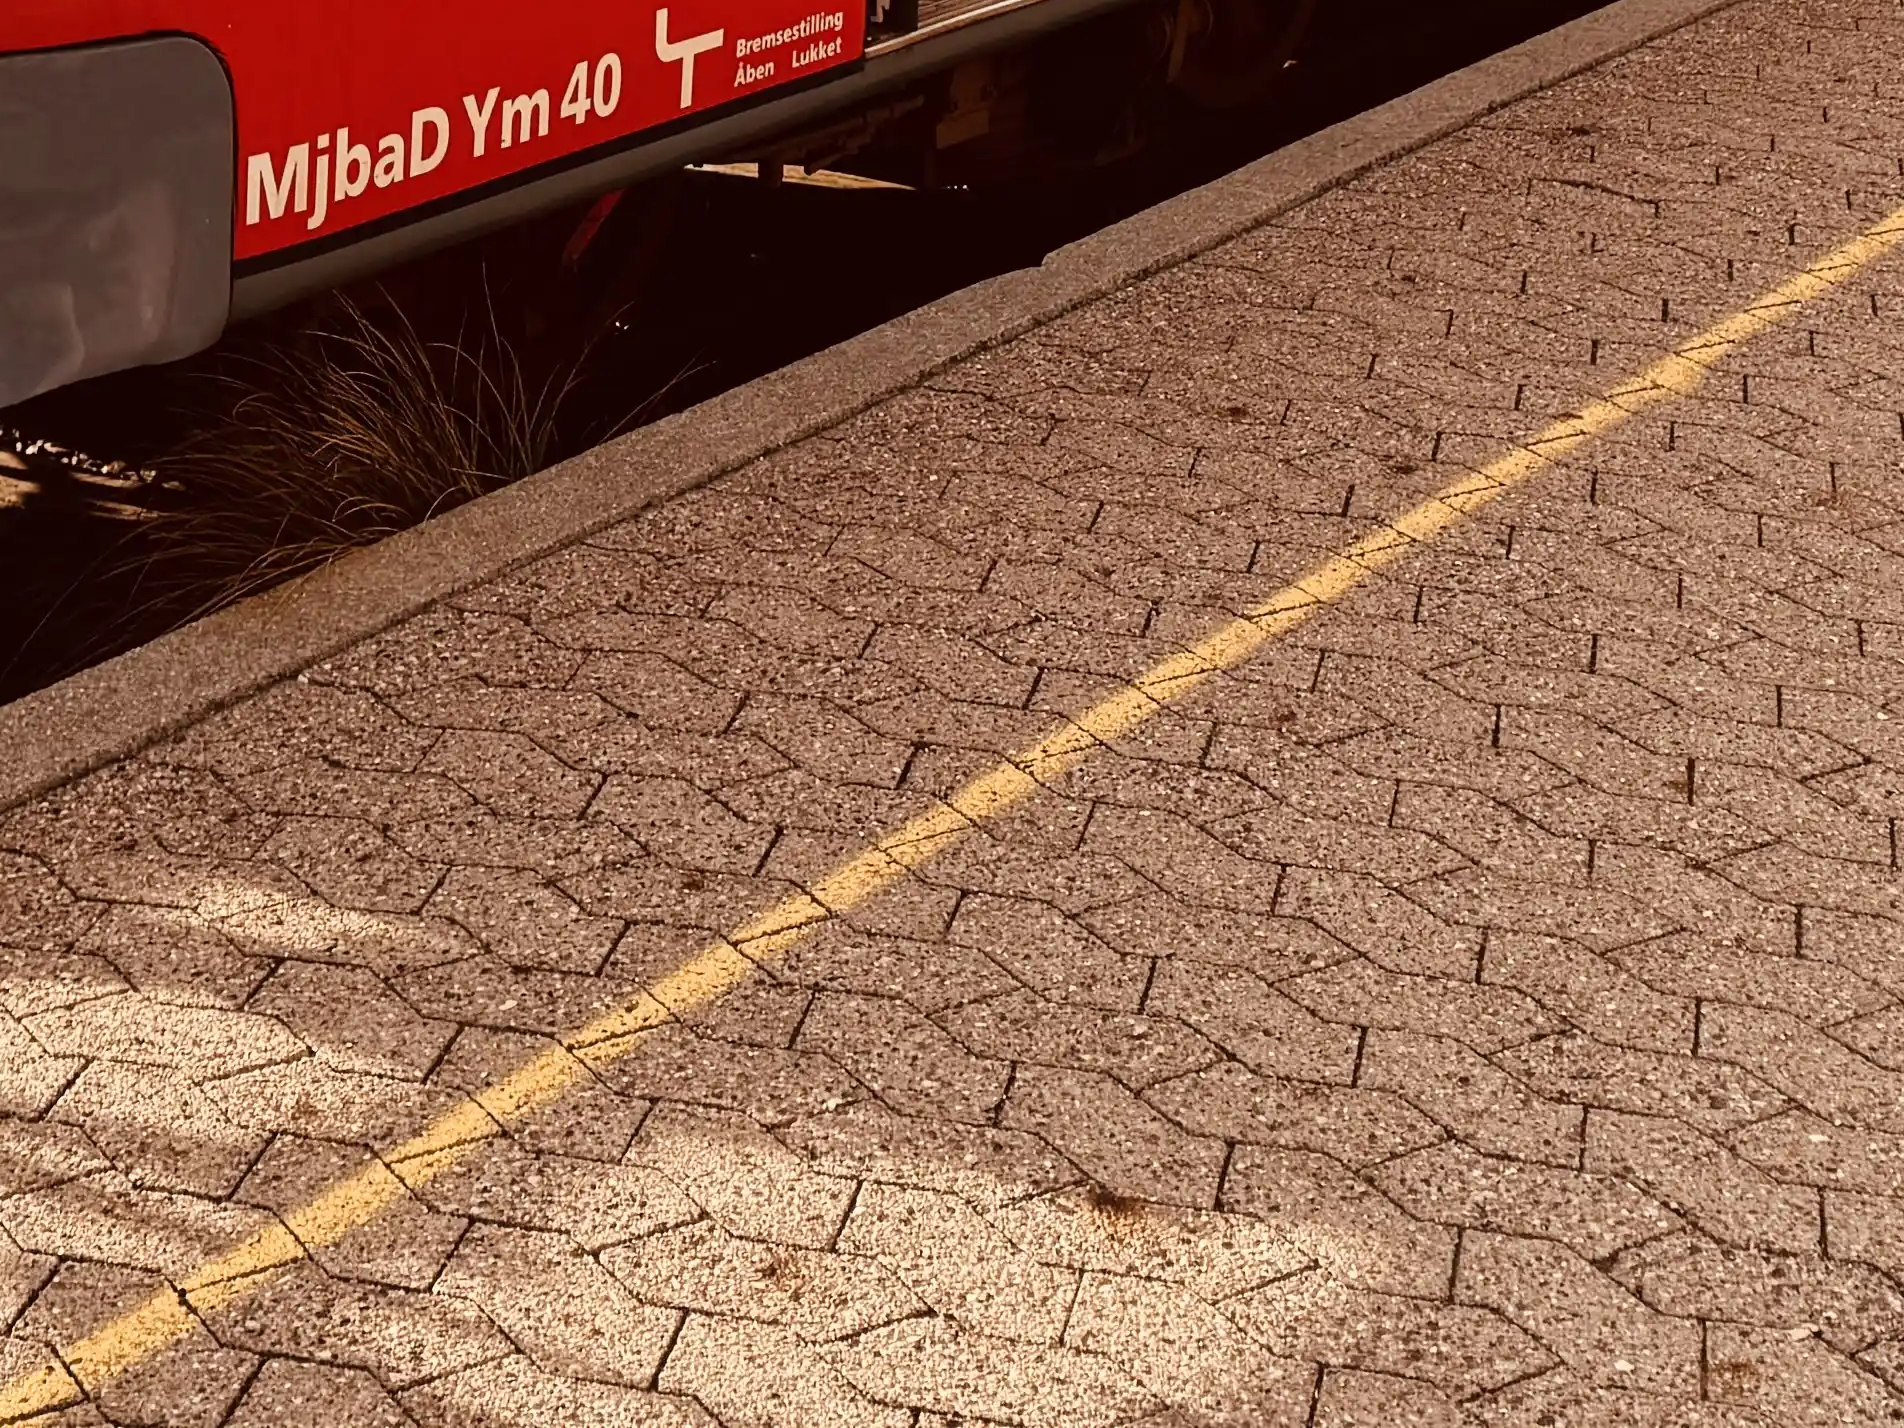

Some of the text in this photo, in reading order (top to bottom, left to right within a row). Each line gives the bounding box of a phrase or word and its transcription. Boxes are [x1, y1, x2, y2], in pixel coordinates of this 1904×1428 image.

[735, 11, 845, 59] Bremsestilling
[734, 36, 843, 88] Åben Lukket
[245, 52, 622, 231] MjbaD Ym 40
